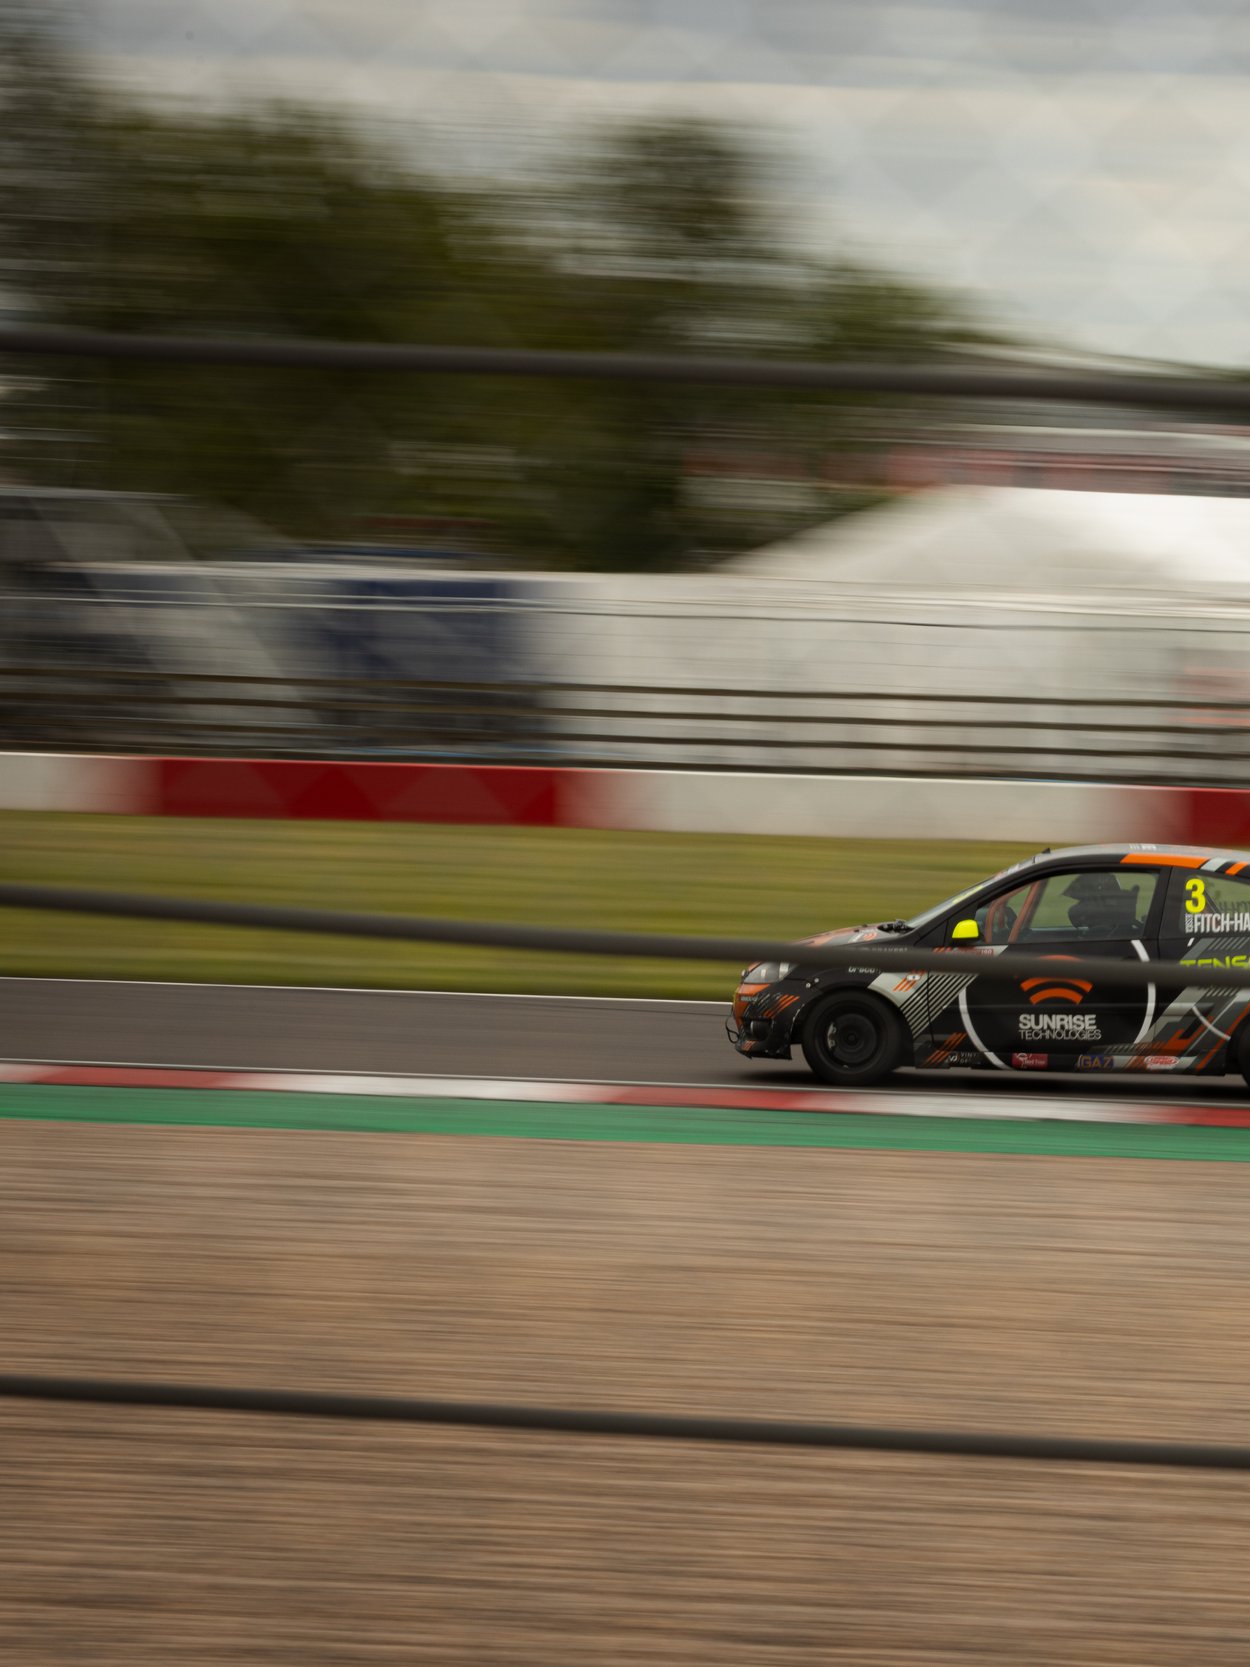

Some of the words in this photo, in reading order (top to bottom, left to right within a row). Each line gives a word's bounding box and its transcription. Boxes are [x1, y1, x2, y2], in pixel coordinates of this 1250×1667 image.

[1185, 878, 1206, 914] 3
[1018, 1013, 1098, 1030] SUNRISE
[1019, 1029, 1102, 1040] TECHNOLOGIES
